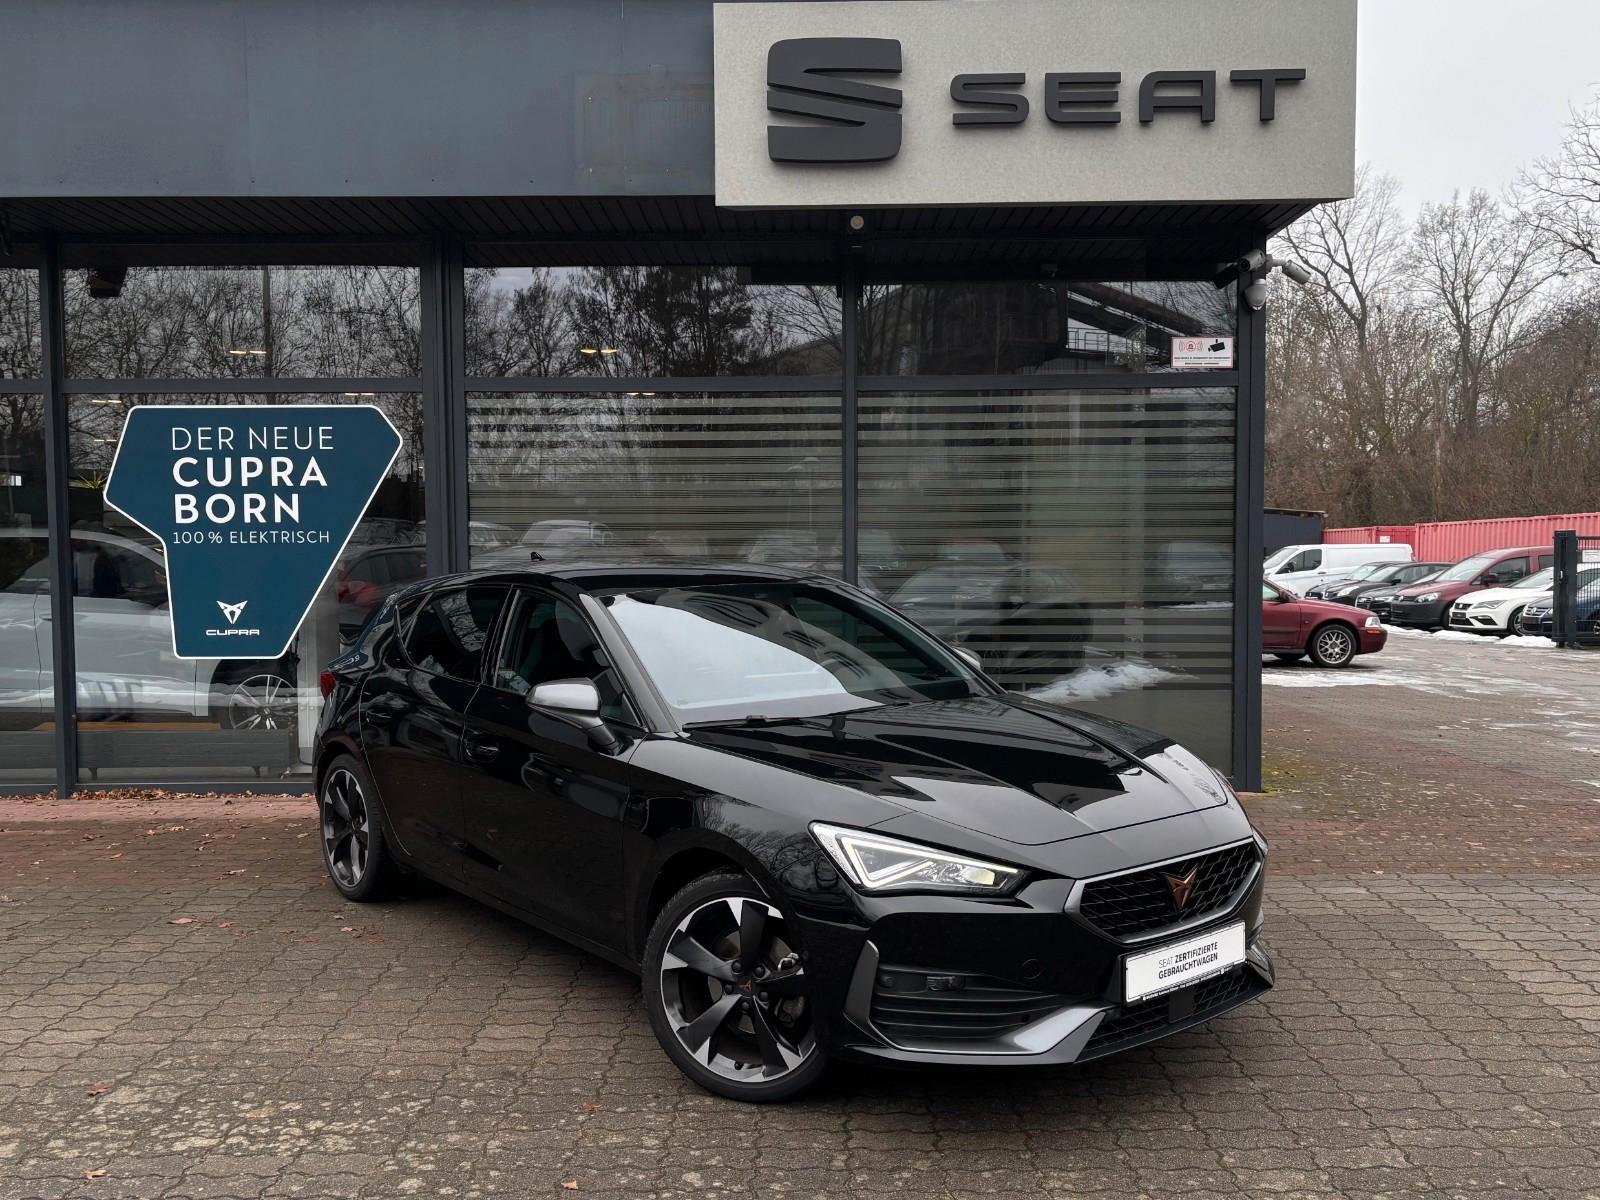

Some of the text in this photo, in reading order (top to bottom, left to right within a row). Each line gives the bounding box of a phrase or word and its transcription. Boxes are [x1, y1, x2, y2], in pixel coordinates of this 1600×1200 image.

[950, 68, 1307, 127] SEAT
[171, 426, 334, 451] DER NEUE
[172, 456, 328, 487] CUPRA
[175, 493, 300, 524] BORN
[229, 530, 330, 544] ELEKTRISCH
[1158, 941, 1218, 969] SEAT ZERTIFIZIERTE
[1158, 952, 1218, 980] GEBRAUCHTWAGEN
